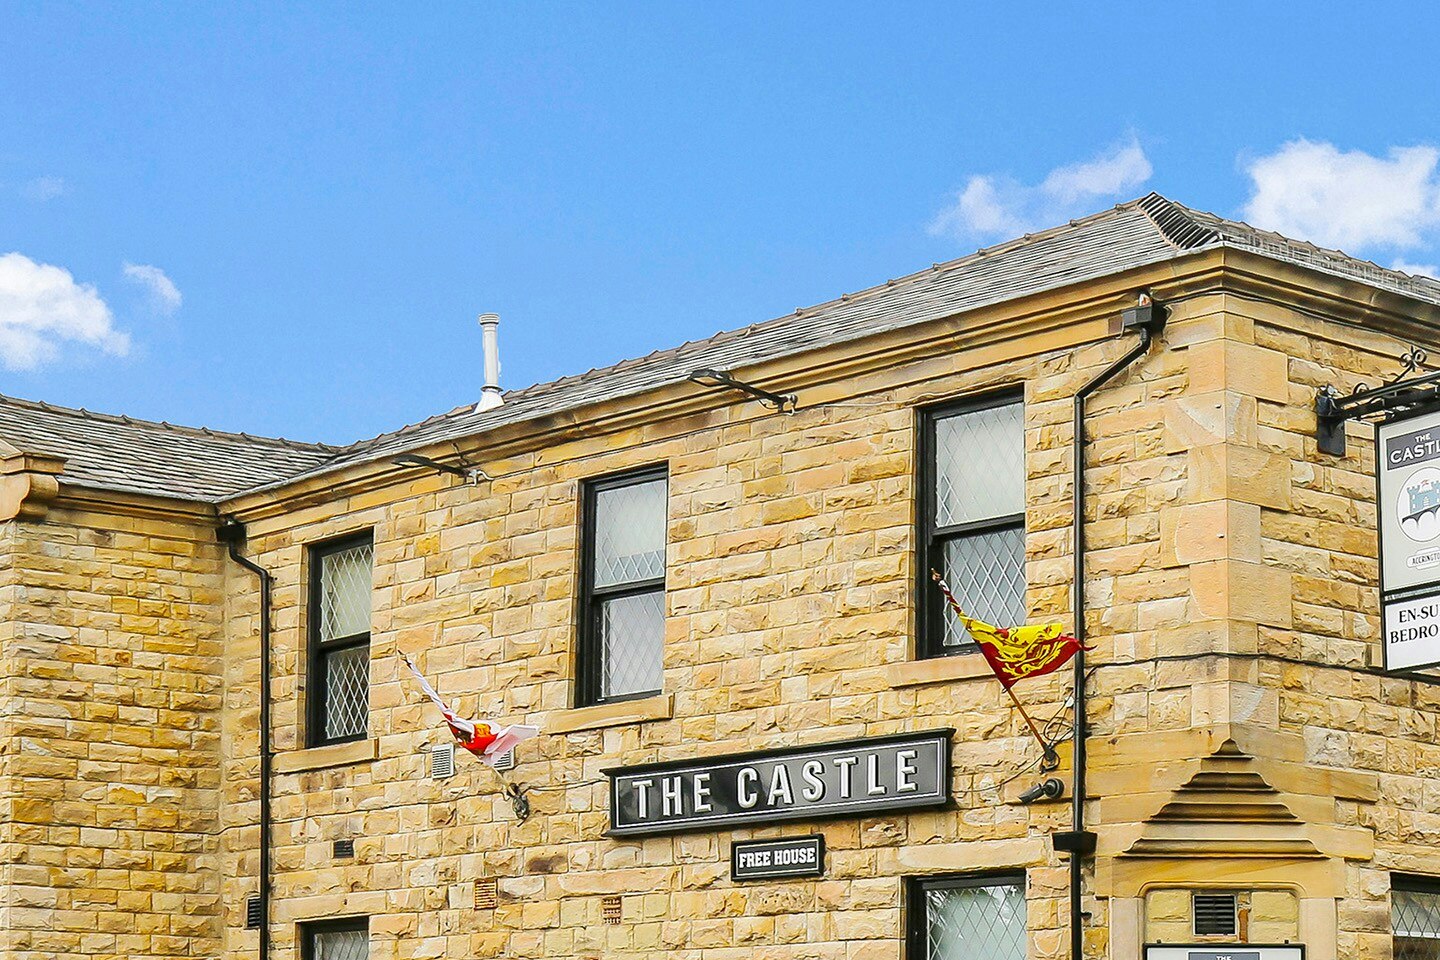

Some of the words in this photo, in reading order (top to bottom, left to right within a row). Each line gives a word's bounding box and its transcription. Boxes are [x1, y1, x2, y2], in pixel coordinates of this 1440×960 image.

[1415, 432, 1431, 442] THE
[631, 772, 713, 819] THE
[737, 750, 919, 809] CASTLE
[738, 850, 771, 869] FREE
[774, 847, 816, 867] HOUSE
